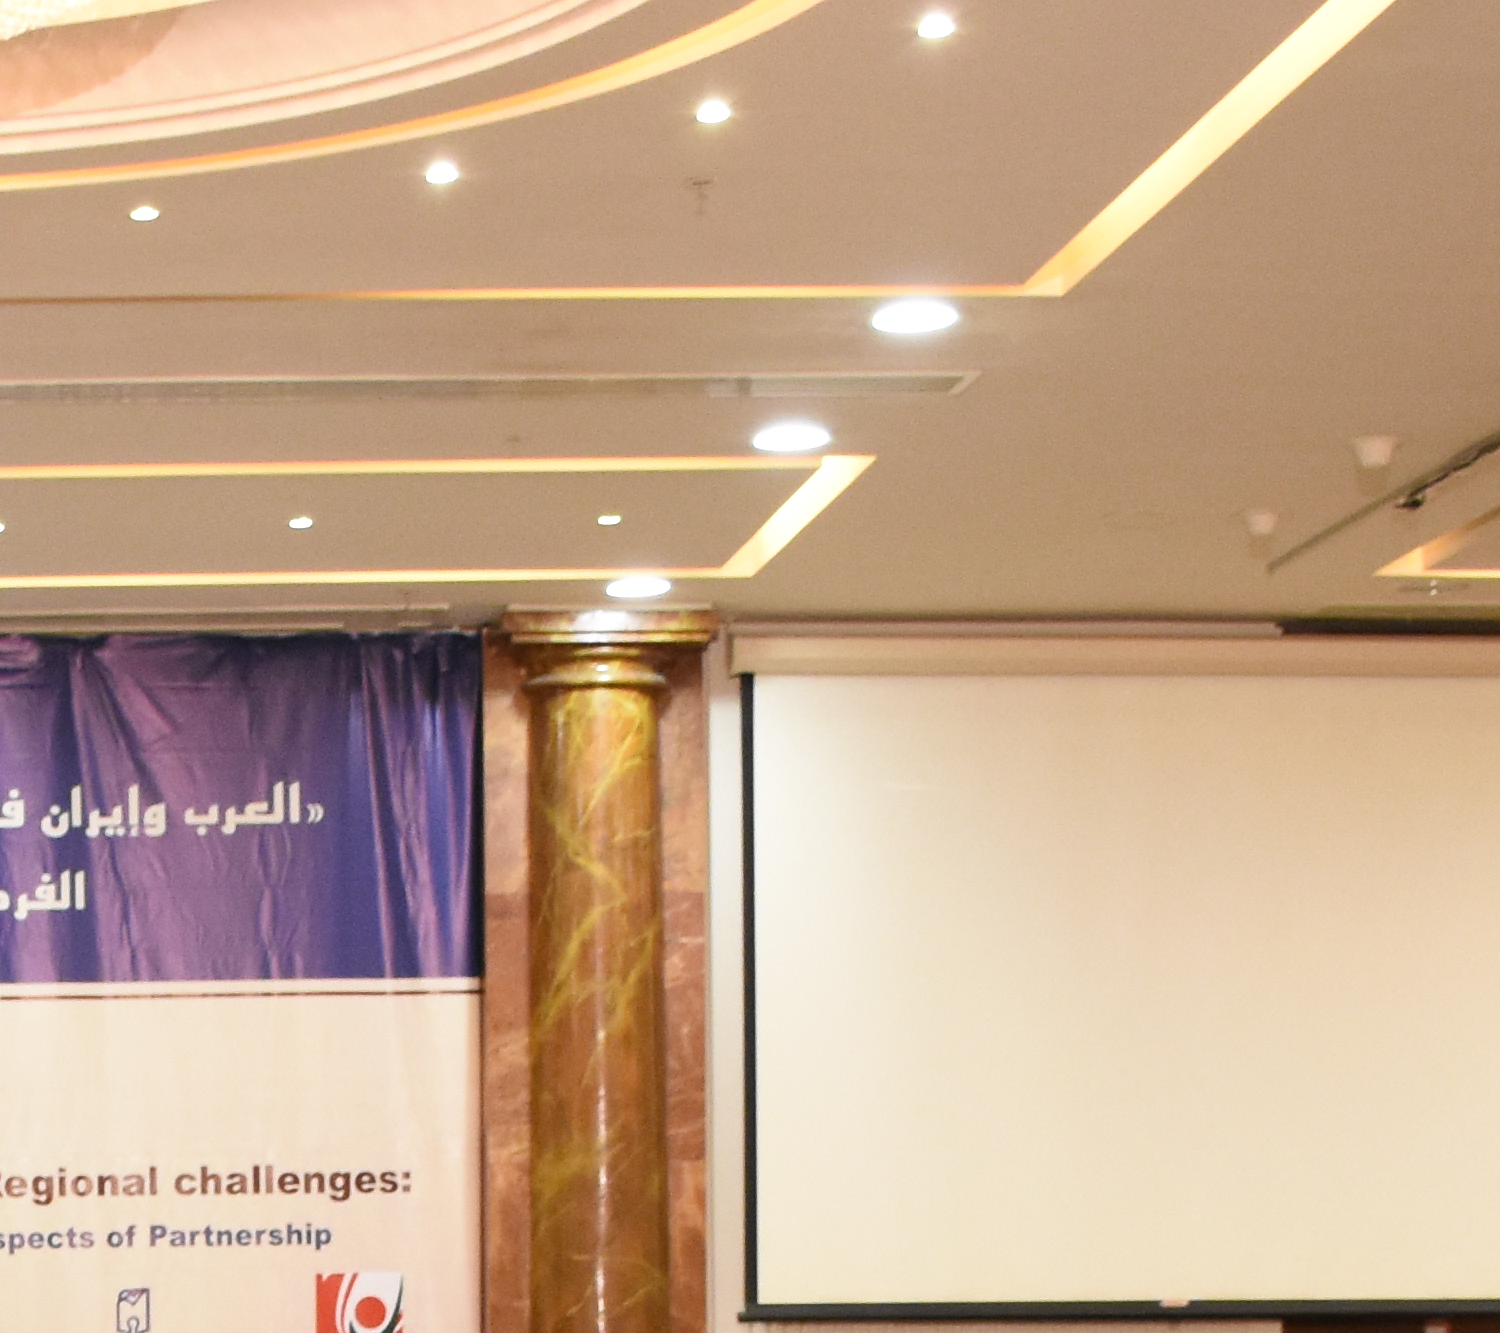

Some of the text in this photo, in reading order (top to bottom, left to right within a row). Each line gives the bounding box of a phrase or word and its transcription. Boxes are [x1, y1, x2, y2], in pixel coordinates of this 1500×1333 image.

[173, 1164, 414, 1203] challenges:
[106, 1224, 137, 1248] of
[148, 1222, 333, 1253] Partnership
